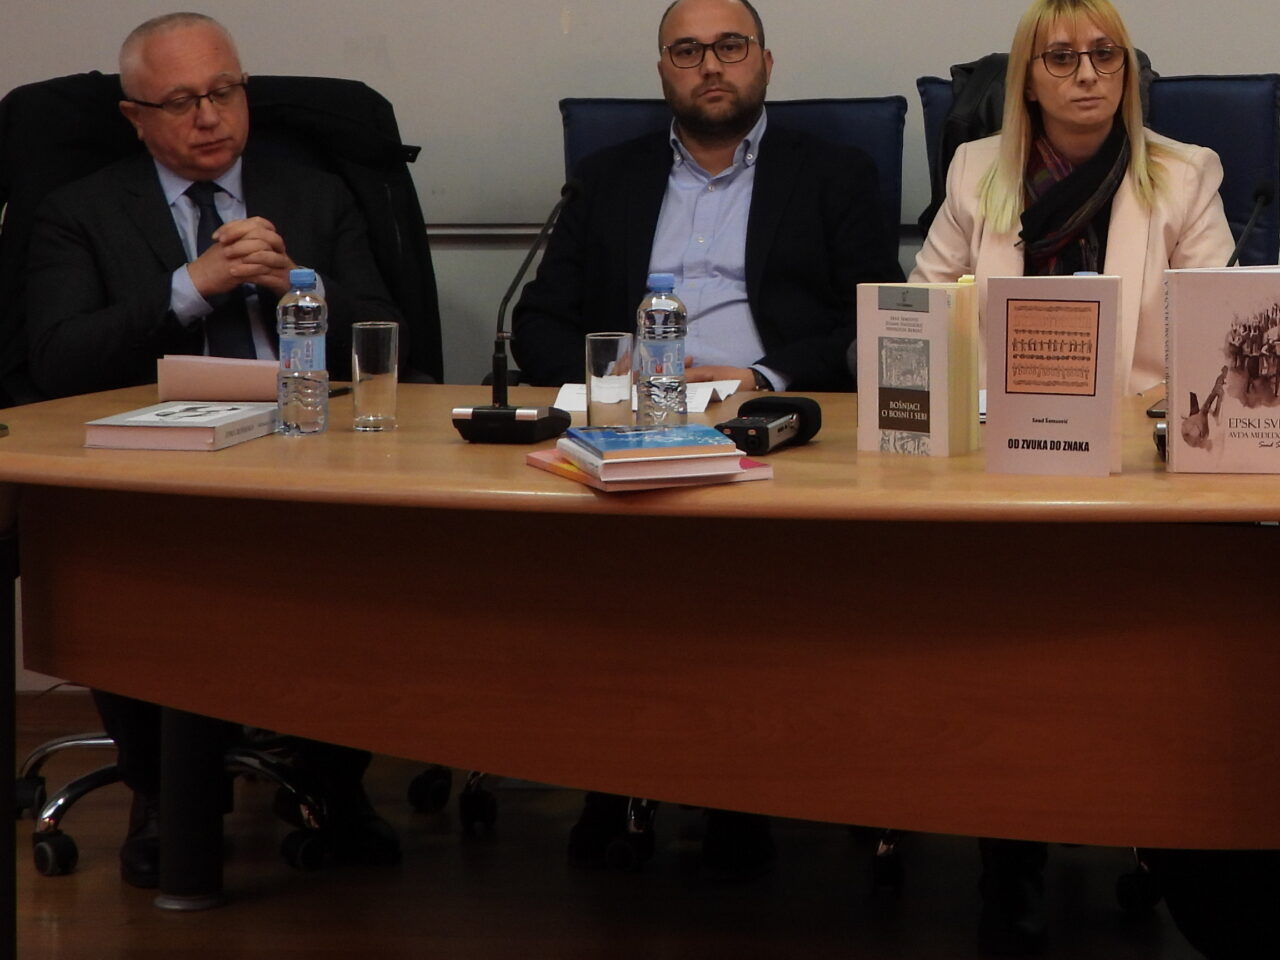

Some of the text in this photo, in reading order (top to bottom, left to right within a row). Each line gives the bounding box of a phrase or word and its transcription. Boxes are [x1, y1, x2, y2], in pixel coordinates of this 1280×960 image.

[889, 400, 920, 411] BOŠNJACI
[888, 410, 909, 419] BOSNI
[1228, 418, 1261, 429] EPSKI
[1007, 438, 1090, 452] OD ZVUKA DO ZNAKA
